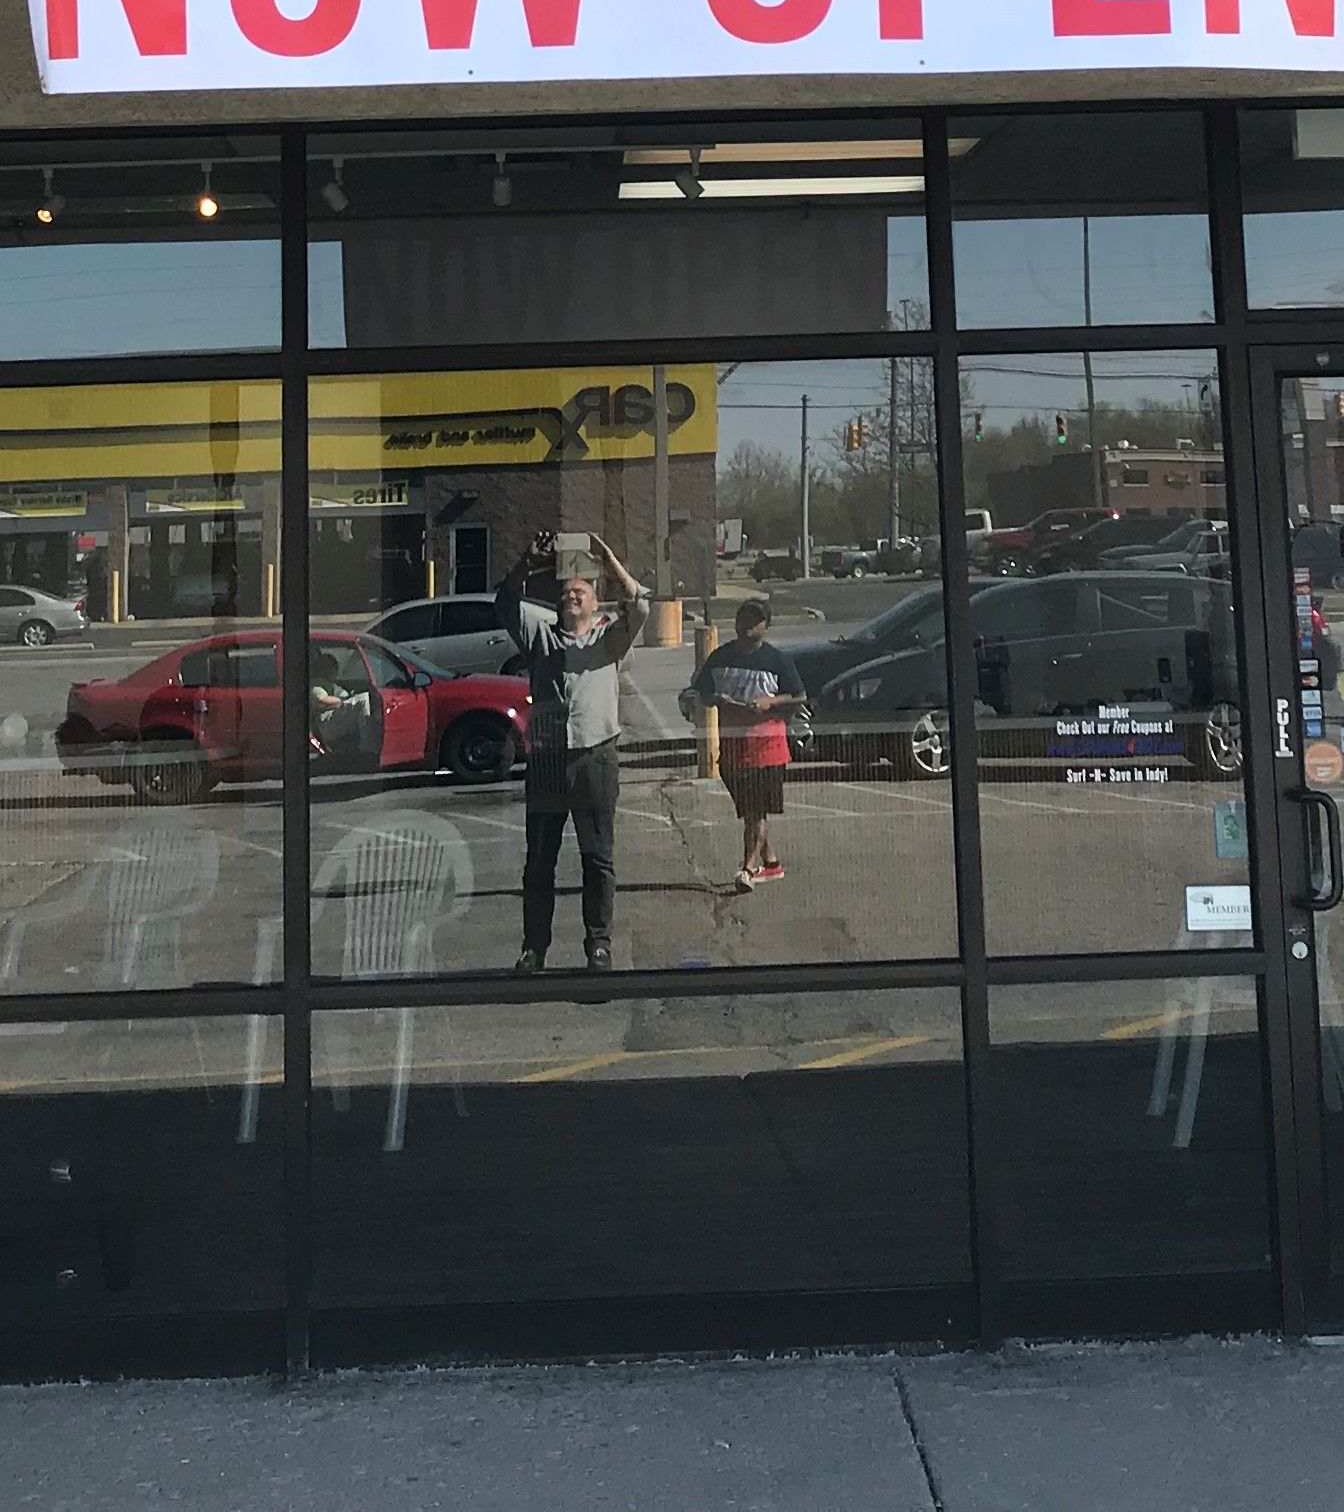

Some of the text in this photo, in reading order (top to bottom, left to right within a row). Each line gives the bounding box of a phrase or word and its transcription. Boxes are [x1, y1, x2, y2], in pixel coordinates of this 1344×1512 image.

[1081, 720, 1096, 735] Out
[1275, 698, 1294, 757] PULL
[1109, 767, 1132, 782] Save
[1207, 904, 1251, 915] MEMBER
